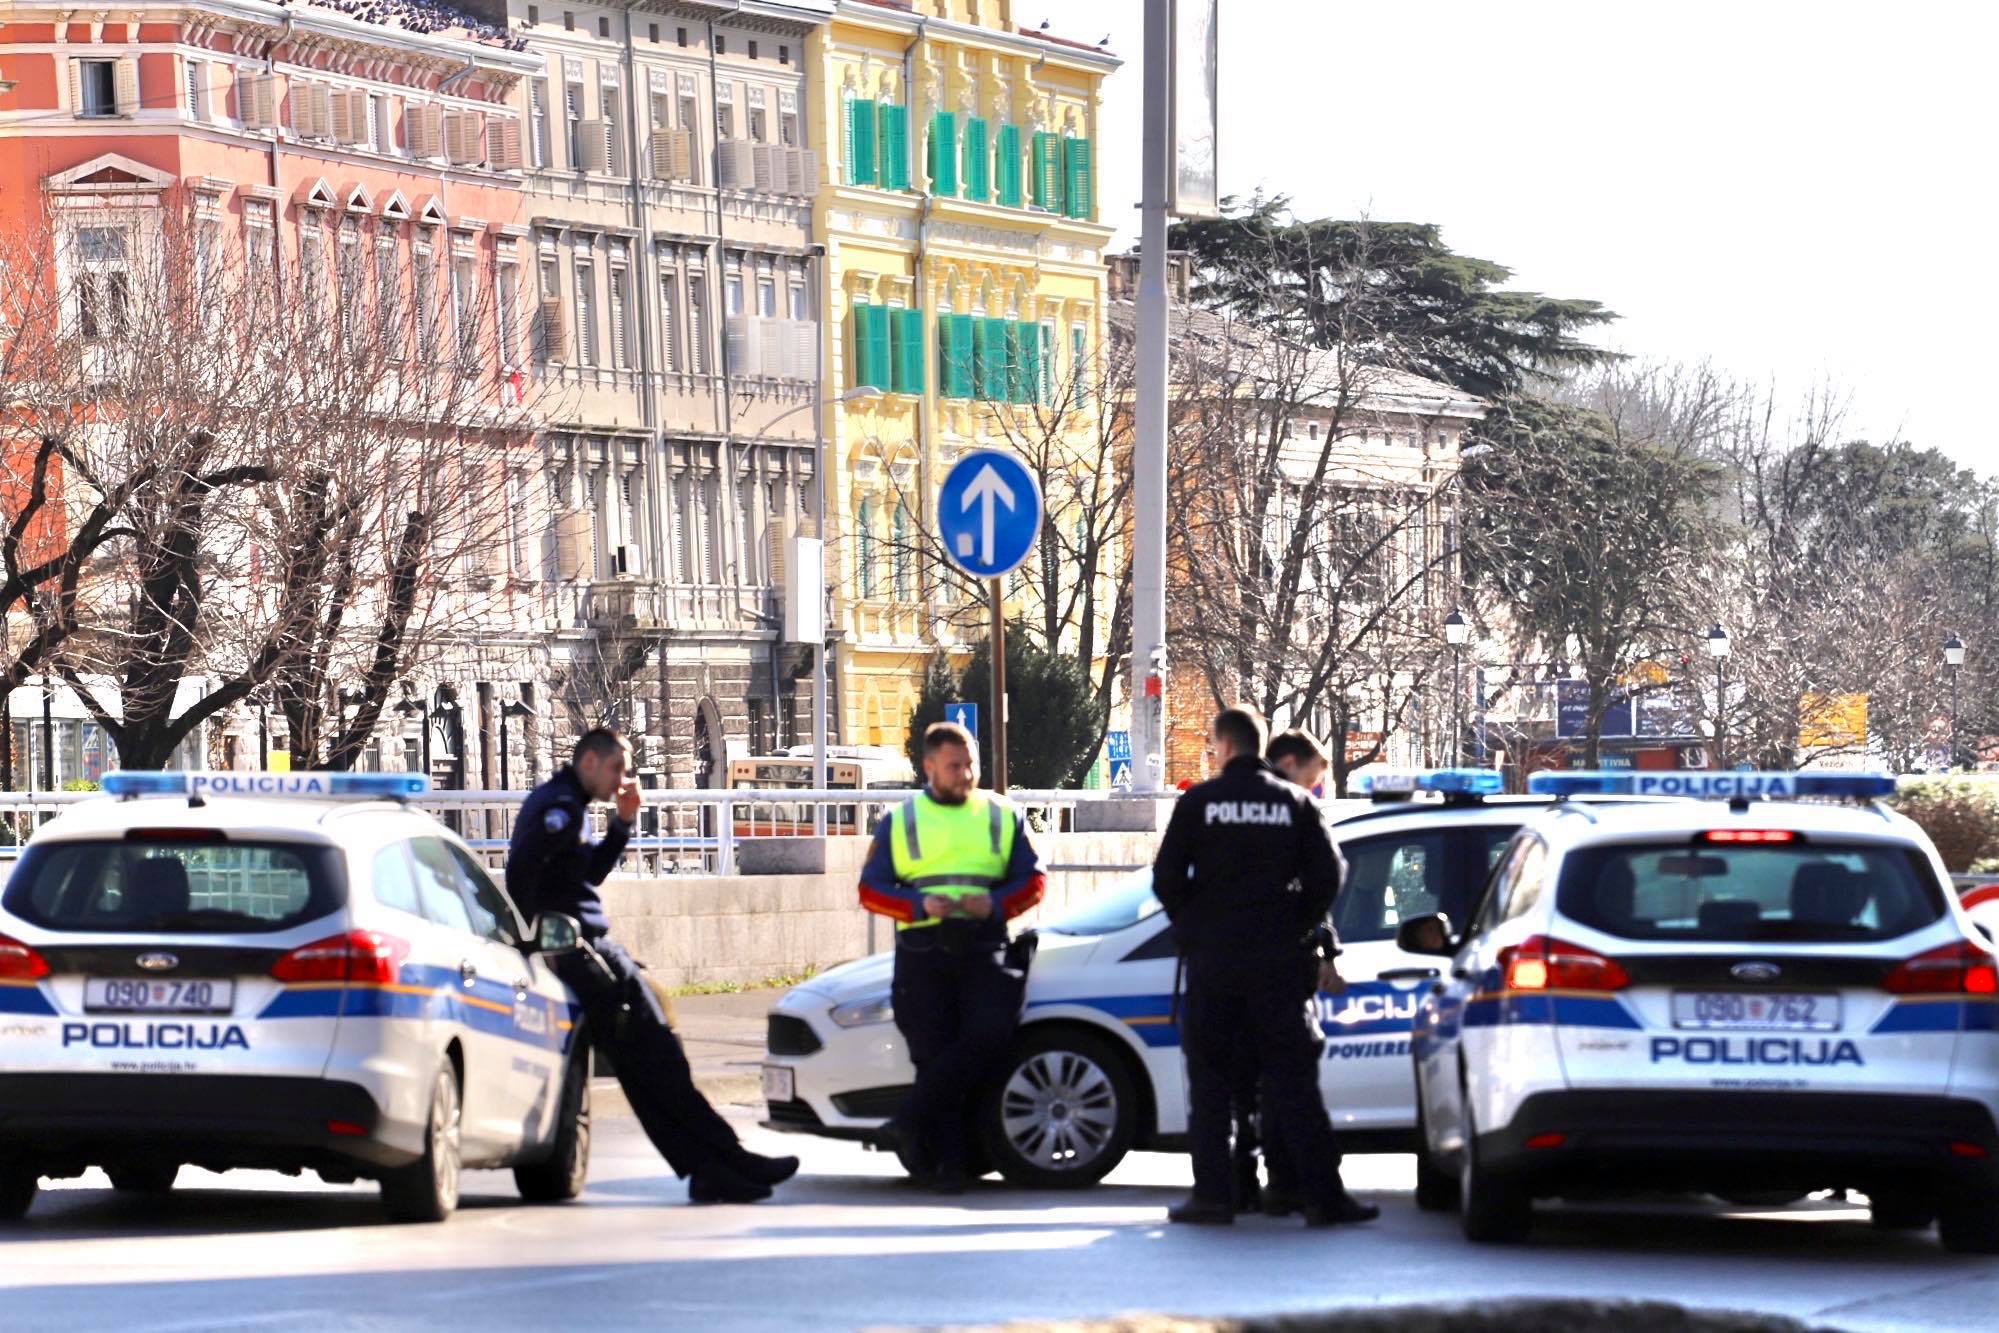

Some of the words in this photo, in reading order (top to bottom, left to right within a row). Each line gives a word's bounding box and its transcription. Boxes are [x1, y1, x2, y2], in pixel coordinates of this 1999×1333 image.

[193, 776, 322, 793] POLICIJA
[1640, 777, 1787, 794] POLICIJA
[1205, 801, 1292, 826] POLICIJA
[105, 981, 149, 1007] 090
[168, 981, 213, 1007] 740
[1694, 994, 1745, 1021] 090
[1767, 996, 1817, 1023] 762
[62, 1023, 250, 1049] POLICIJA
[1650, 1037, 1865, 1065] POLICIJA
